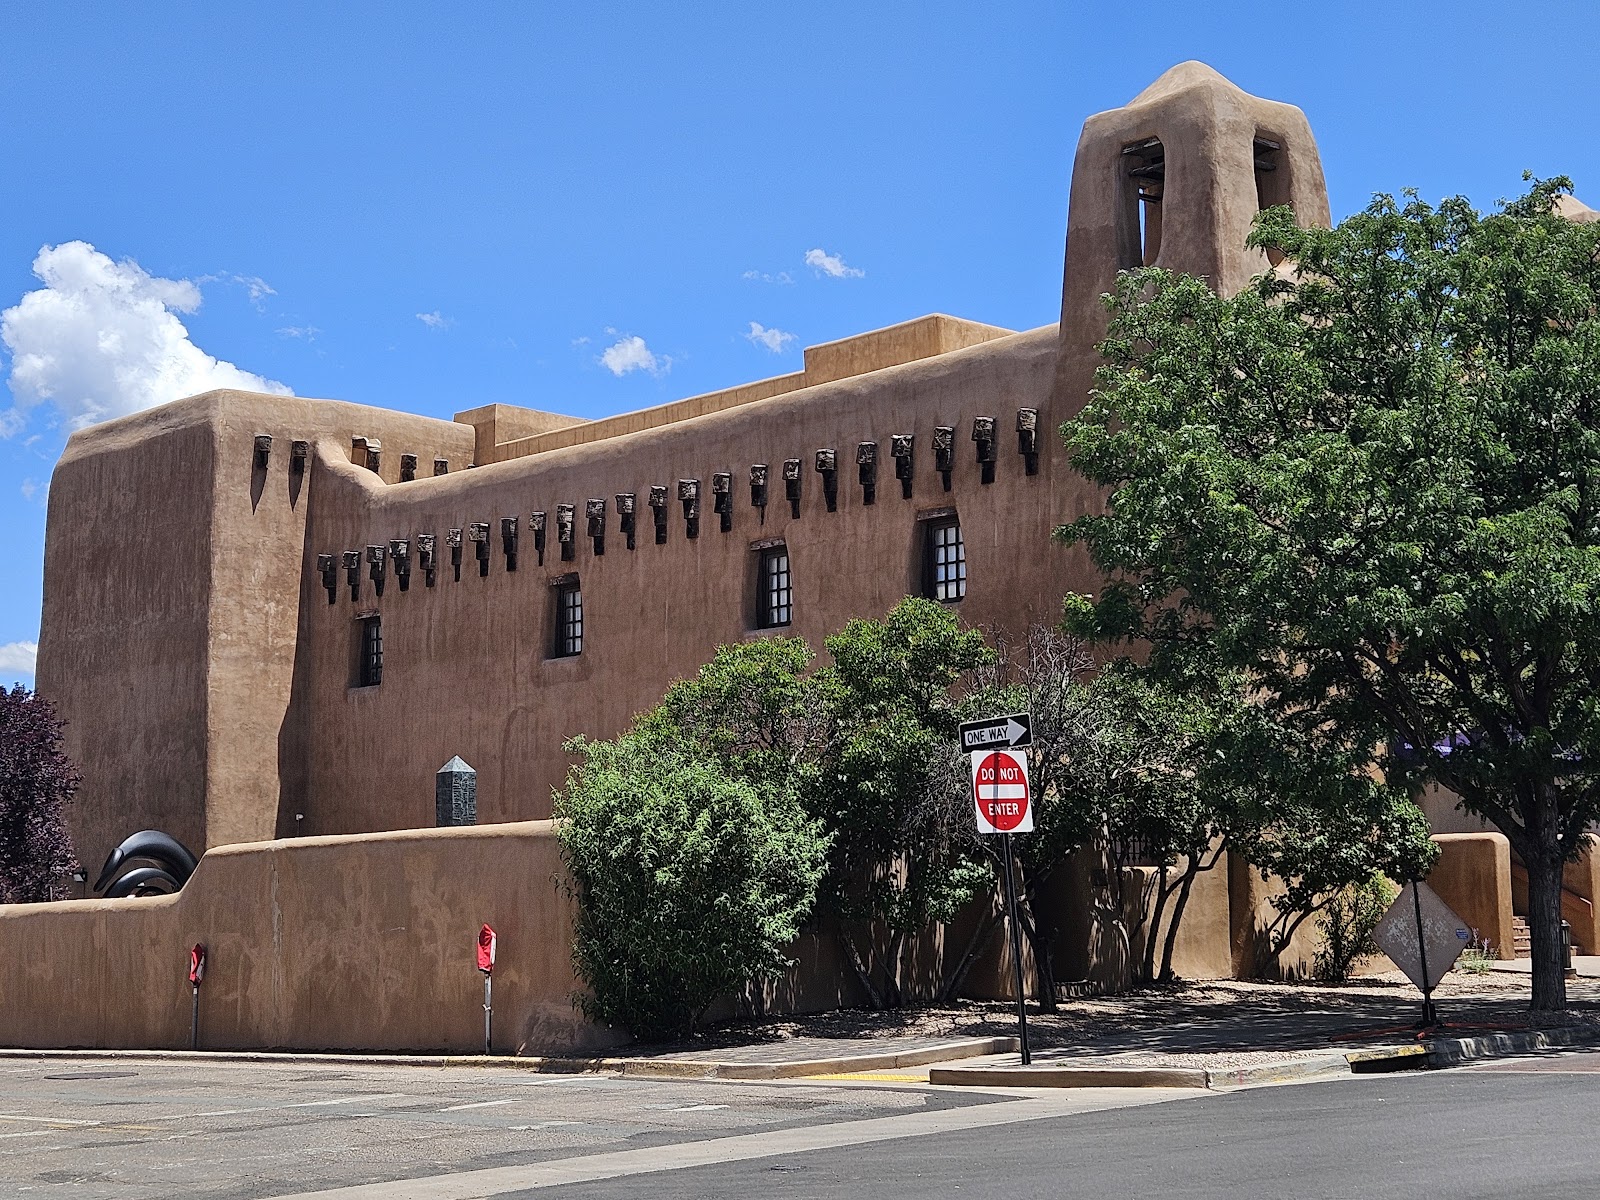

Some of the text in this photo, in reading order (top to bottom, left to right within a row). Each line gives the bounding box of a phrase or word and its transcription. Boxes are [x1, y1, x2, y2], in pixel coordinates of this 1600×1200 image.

[967, 726, 1008, 744] ONE WAY
[981, 767, 1018, 780] DO NOT
[988, 803, 1019, 816] ENTER
